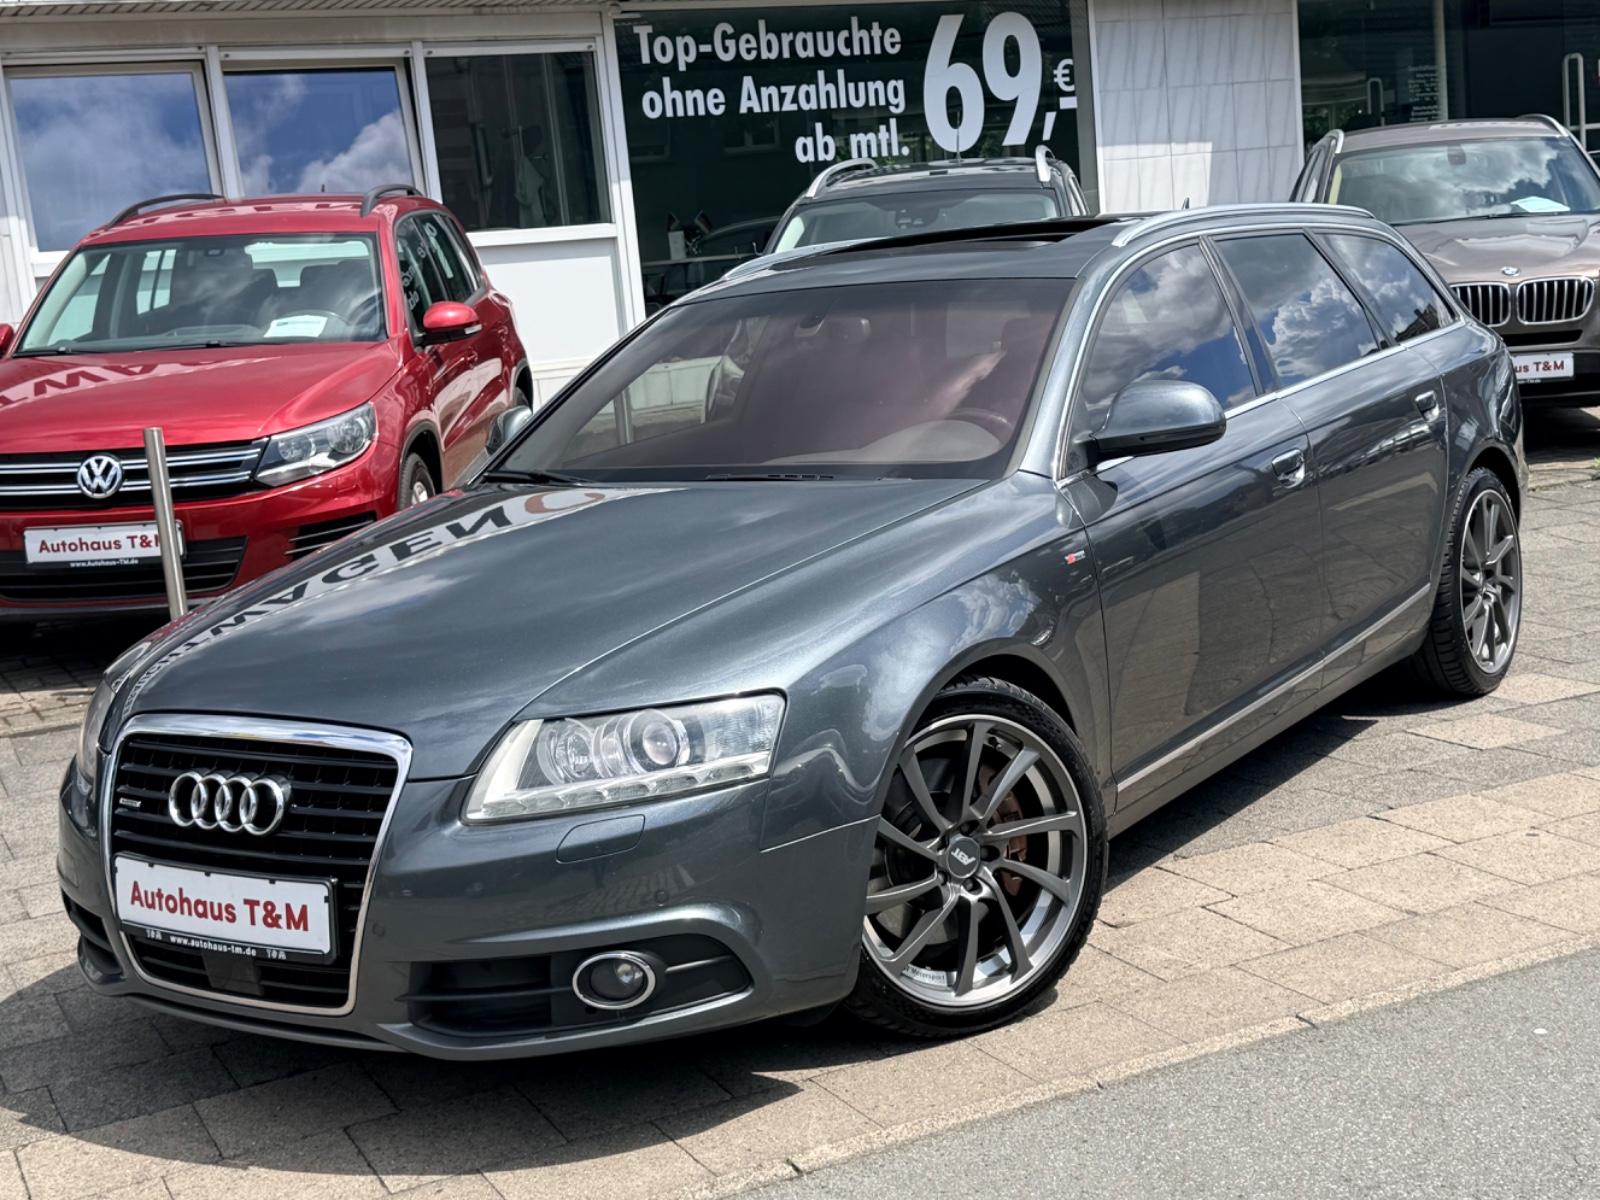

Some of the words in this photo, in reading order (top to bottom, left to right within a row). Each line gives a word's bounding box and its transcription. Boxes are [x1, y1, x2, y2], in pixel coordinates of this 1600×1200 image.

[633, 16, 902, 71] Top-Gebrauchte
[642, 77, 725, 119] ohne
[739, 69, 905, 114] Anzahlung
[795, 123, 836, 163] ab
[850, 118, 910, 160] mtl.
[1533, 360, 1565, 372] T&M
[39, 537, 122, 554] Autohaus
[130, 880, 237, 924] Autohaus
[243, 898, 309, 932] T&M
